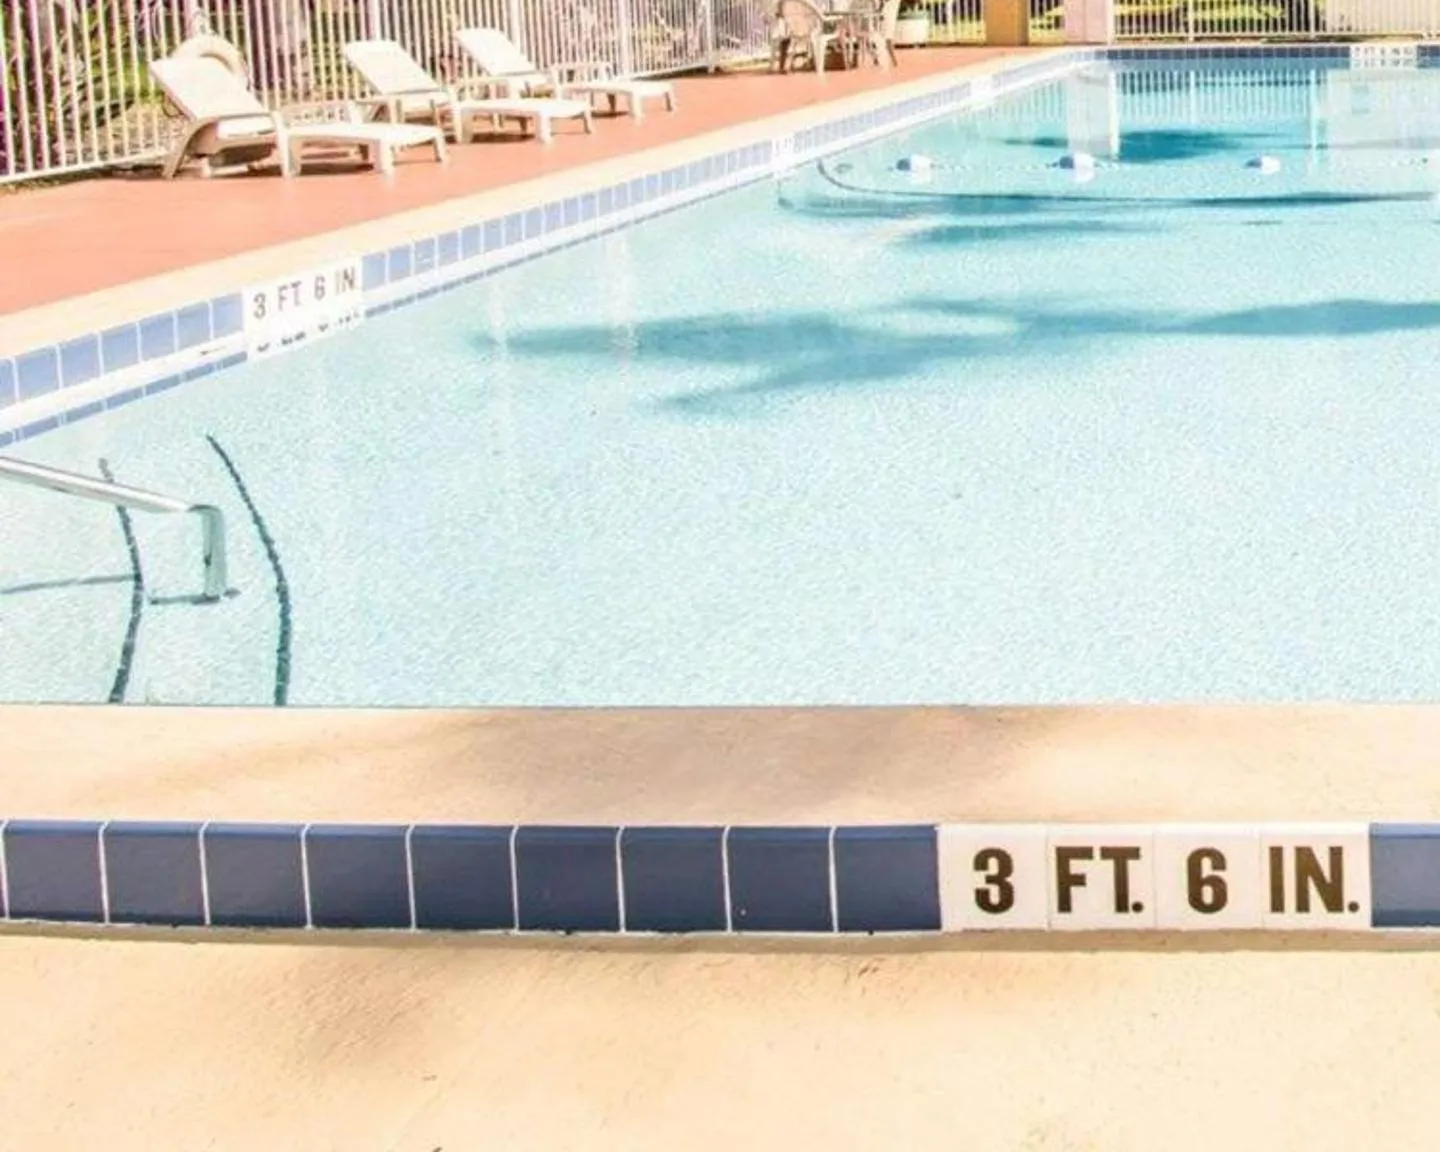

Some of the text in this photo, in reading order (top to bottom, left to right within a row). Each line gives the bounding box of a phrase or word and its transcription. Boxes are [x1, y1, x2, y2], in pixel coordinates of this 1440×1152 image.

[253, 293, 267, 319] 3
[314, 276, 326, 300] 6
[973, 846, 1360, 914] 3 FT. 6 IN.
